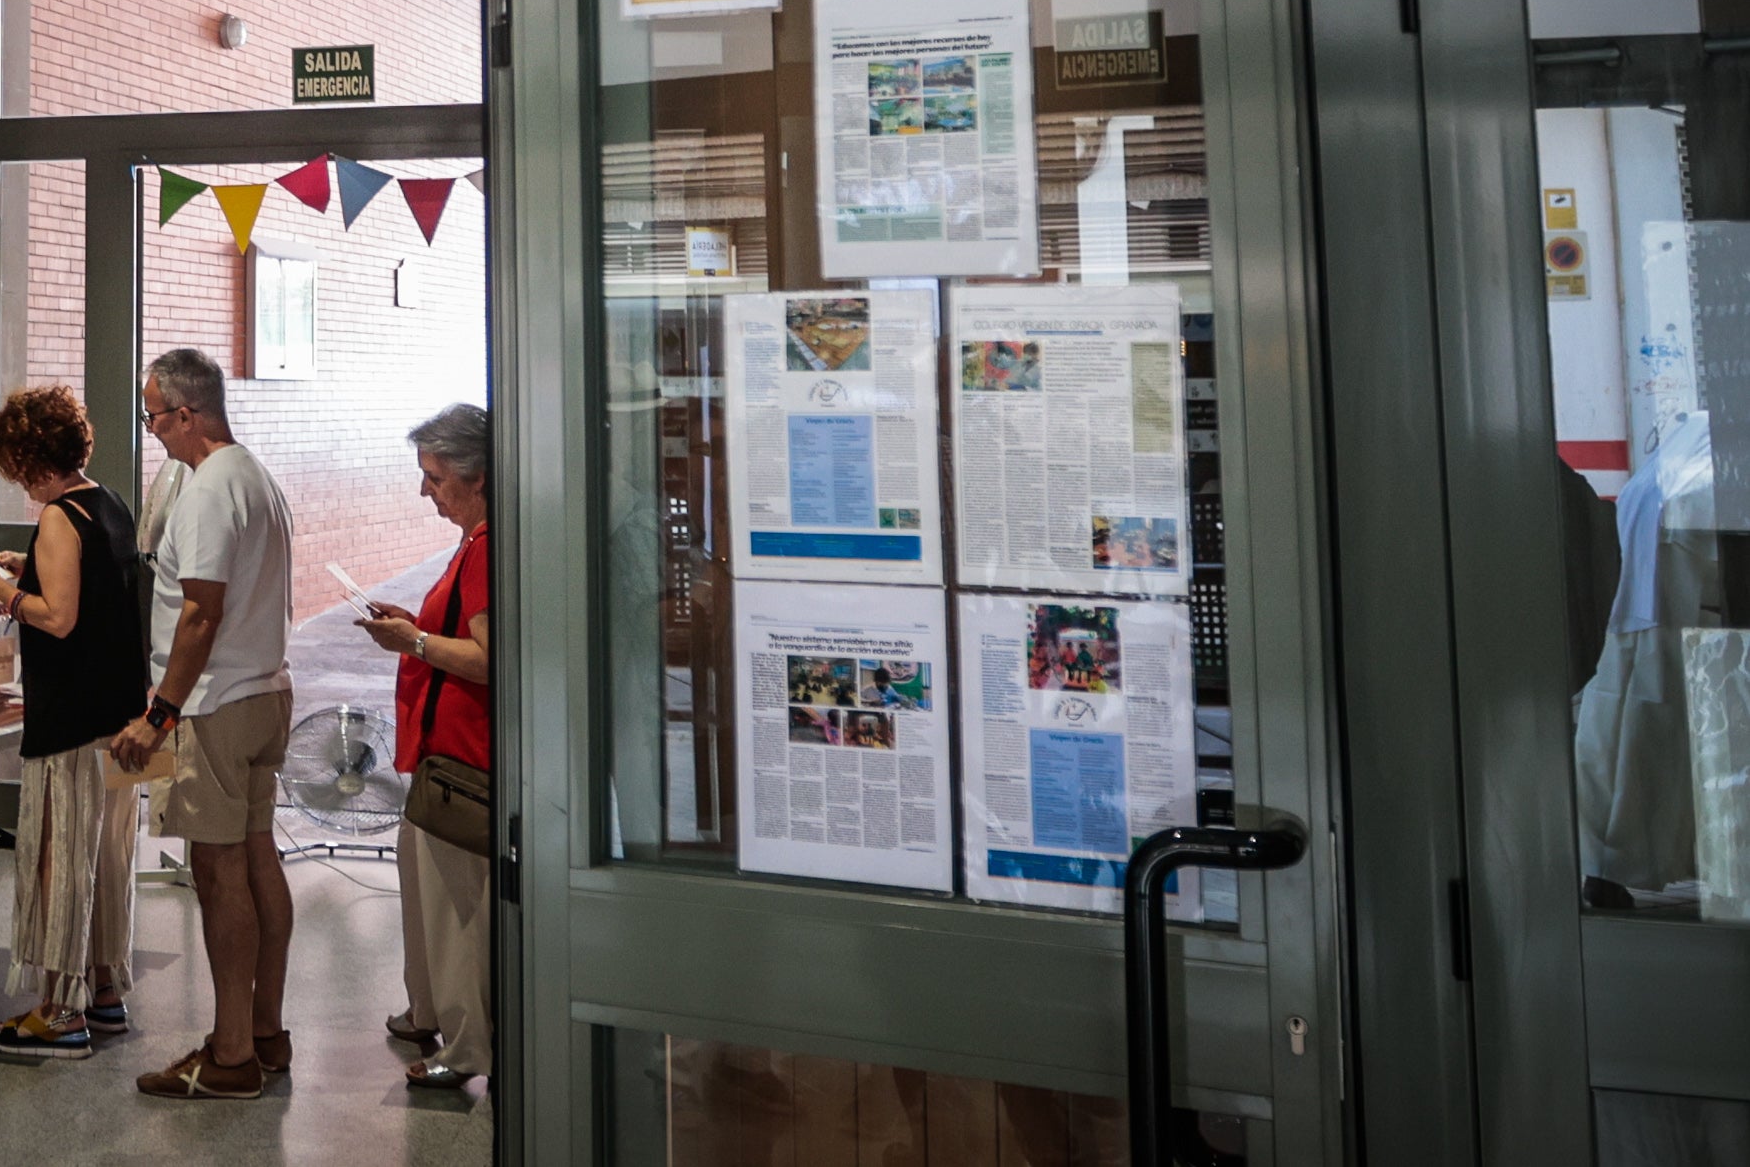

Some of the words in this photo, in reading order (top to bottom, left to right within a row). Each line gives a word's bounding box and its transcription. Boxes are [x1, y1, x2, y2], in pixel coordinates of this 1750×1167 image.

[902, 38, 932, 46] mejores
[933, 36, 965, 44] recursos
[966, 34, 975, 42] de
[977, 33, 991, 43] hoy
[885, 47, 915, 55] mejores
[916, 46, 951, 54] personas
[952, 43, 963, 51] del
[305, 50, 362, 73] SALIDA
[297, 74, 371, 98] EMERGENCIA
[973, 320, 1016, 331] COLEGIO
[1018, 320, 1052, 331] VIRGEN
[1053, 320, 1066, 331] DE
[1109, 320, 1157, 331] GRANADA
[802, 635, 831, 644] sistema
[783, 644, 826, 652] vanguardia
